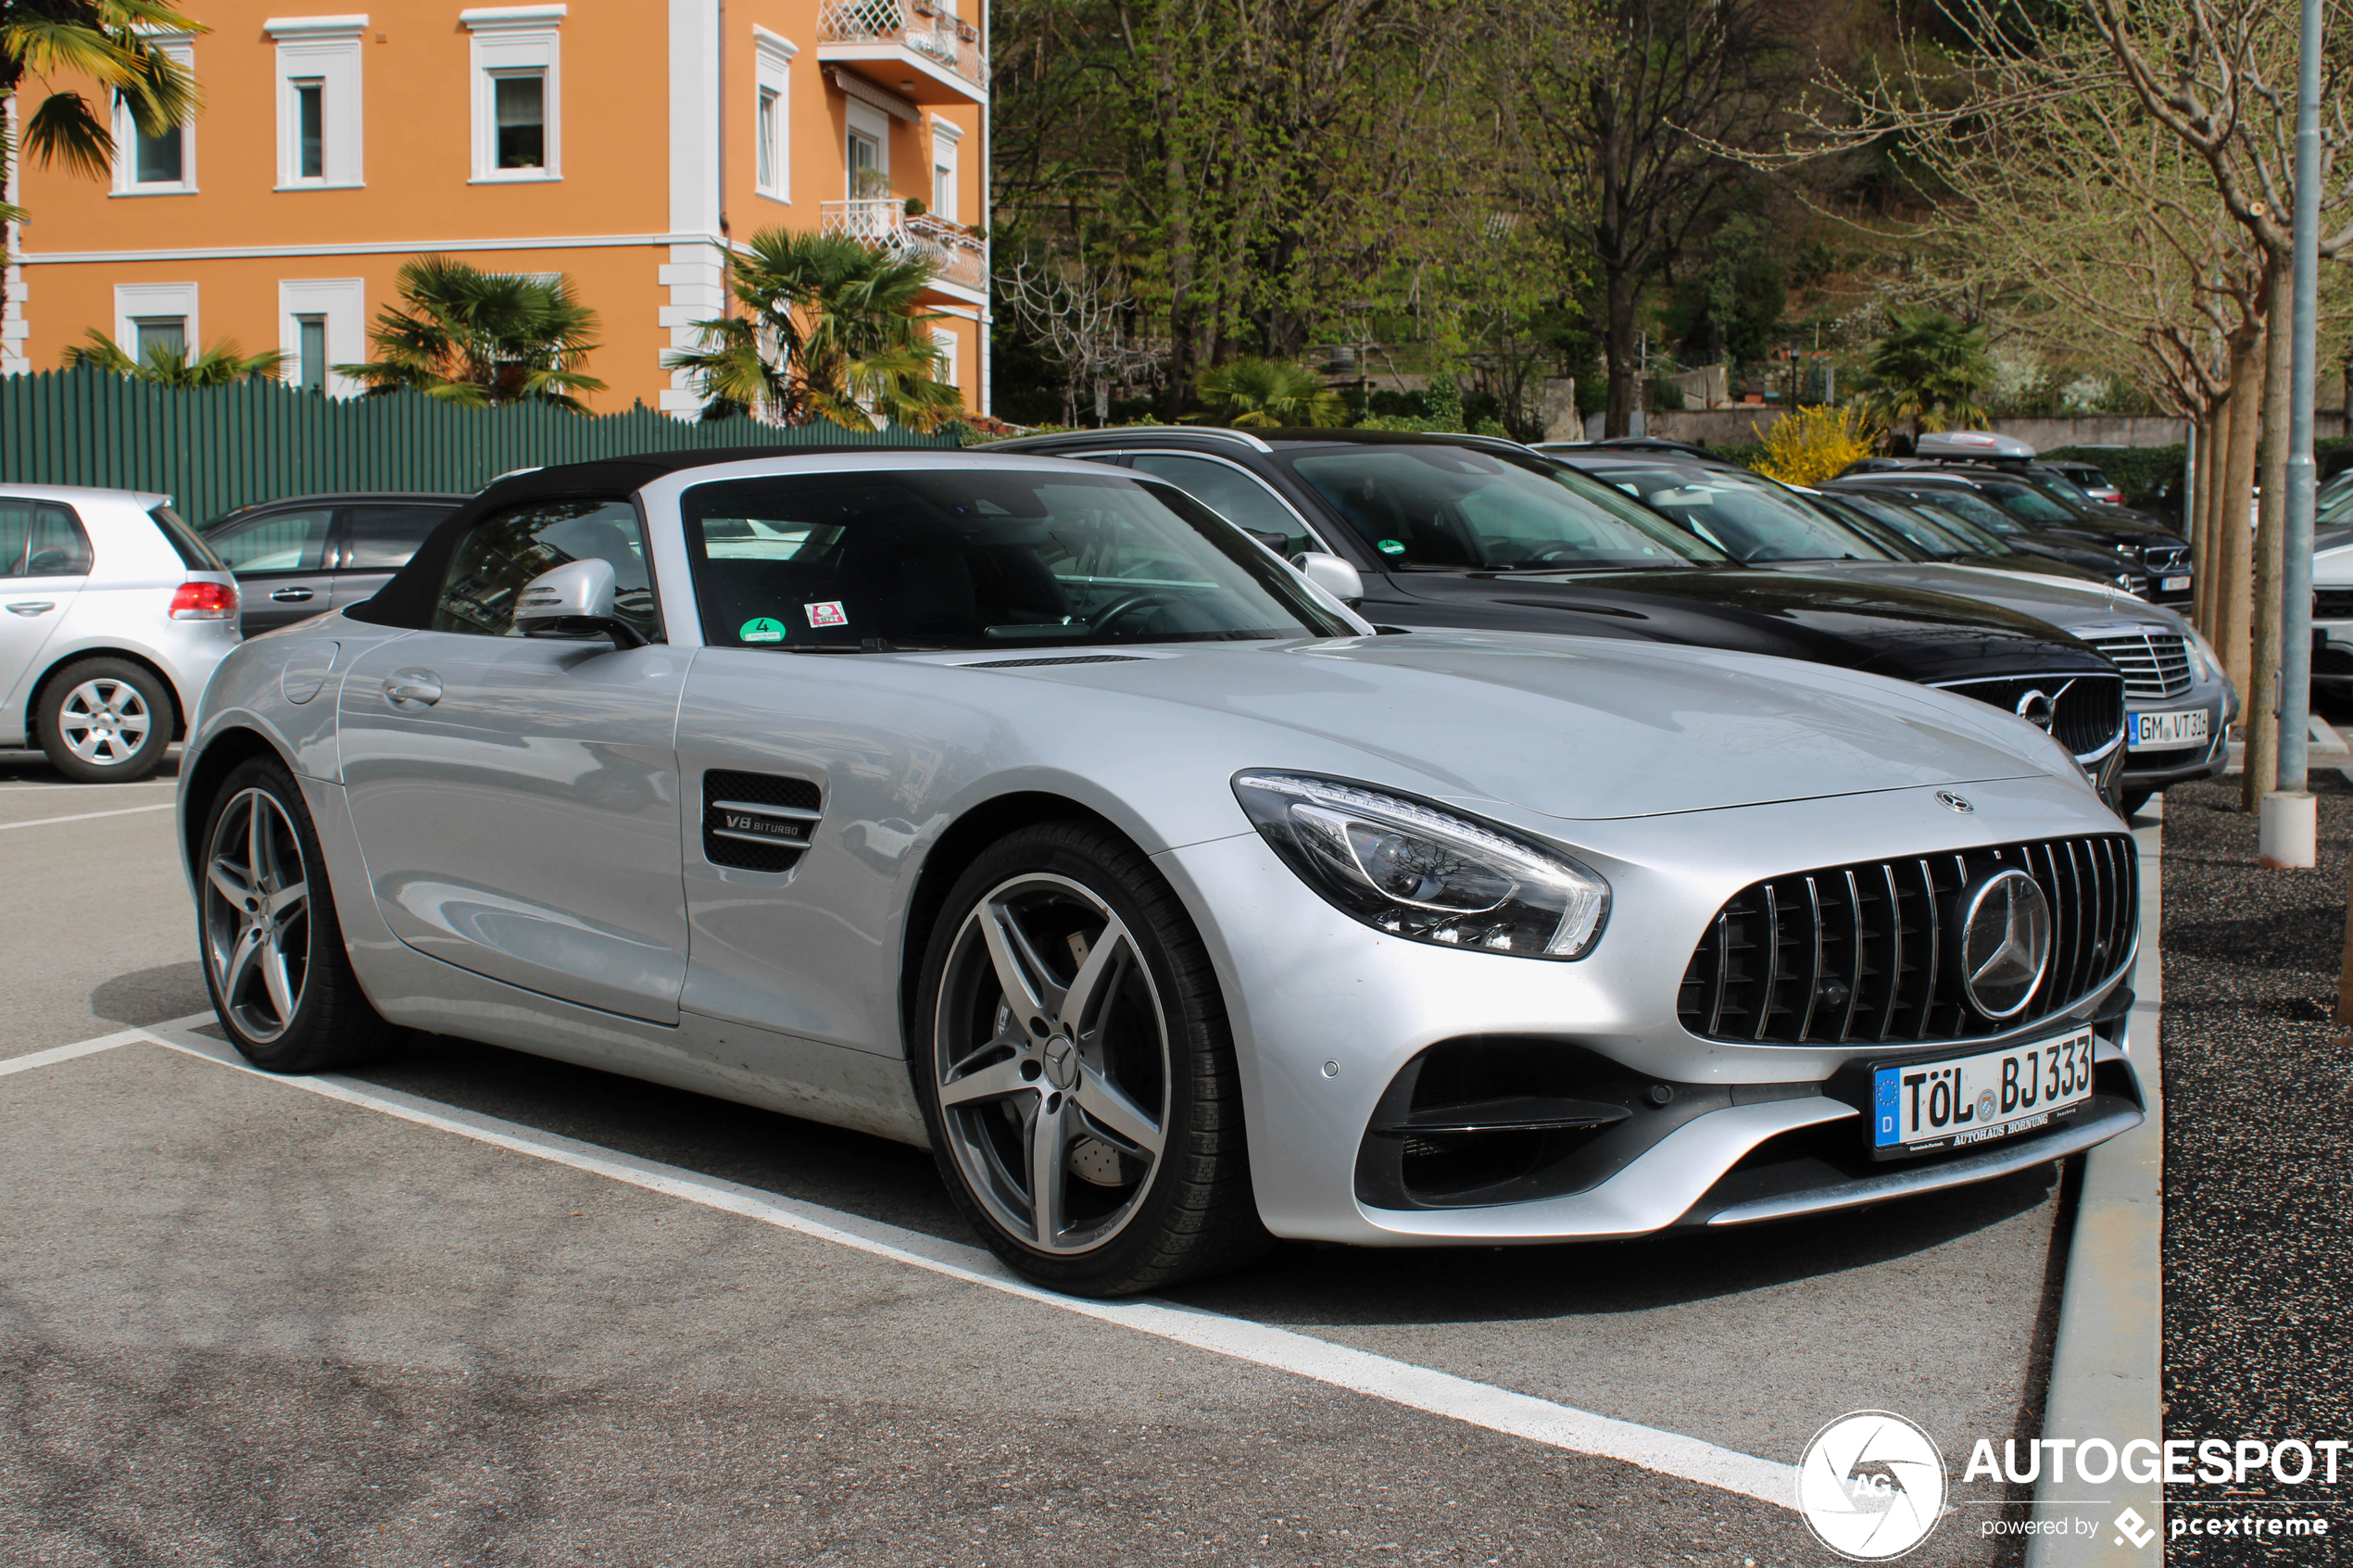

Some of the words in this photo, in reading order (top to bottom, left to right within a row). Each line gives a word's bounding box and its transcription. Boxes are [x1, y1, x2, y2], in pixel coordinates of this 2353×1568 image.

[756, 619, 770, 632] 4
[2140, 716, 2163, 740] GM
[2173, 714, 2190, 738] VT
[726, 815, 752, 829] V8
[753, 822, 799, 835] BITURBO
[1904, 1067, 1974, 1132] TÖL
[2000, 1051, 2039, 1114] BJ
[2045, 1035, 2090, 1101] 333
[1882, 1116, 1893, 1134] D
[1953, 1126, 2006, 1147] AUTOHAUS
[2007, 1113, 2048, 1136] HORNUNG
